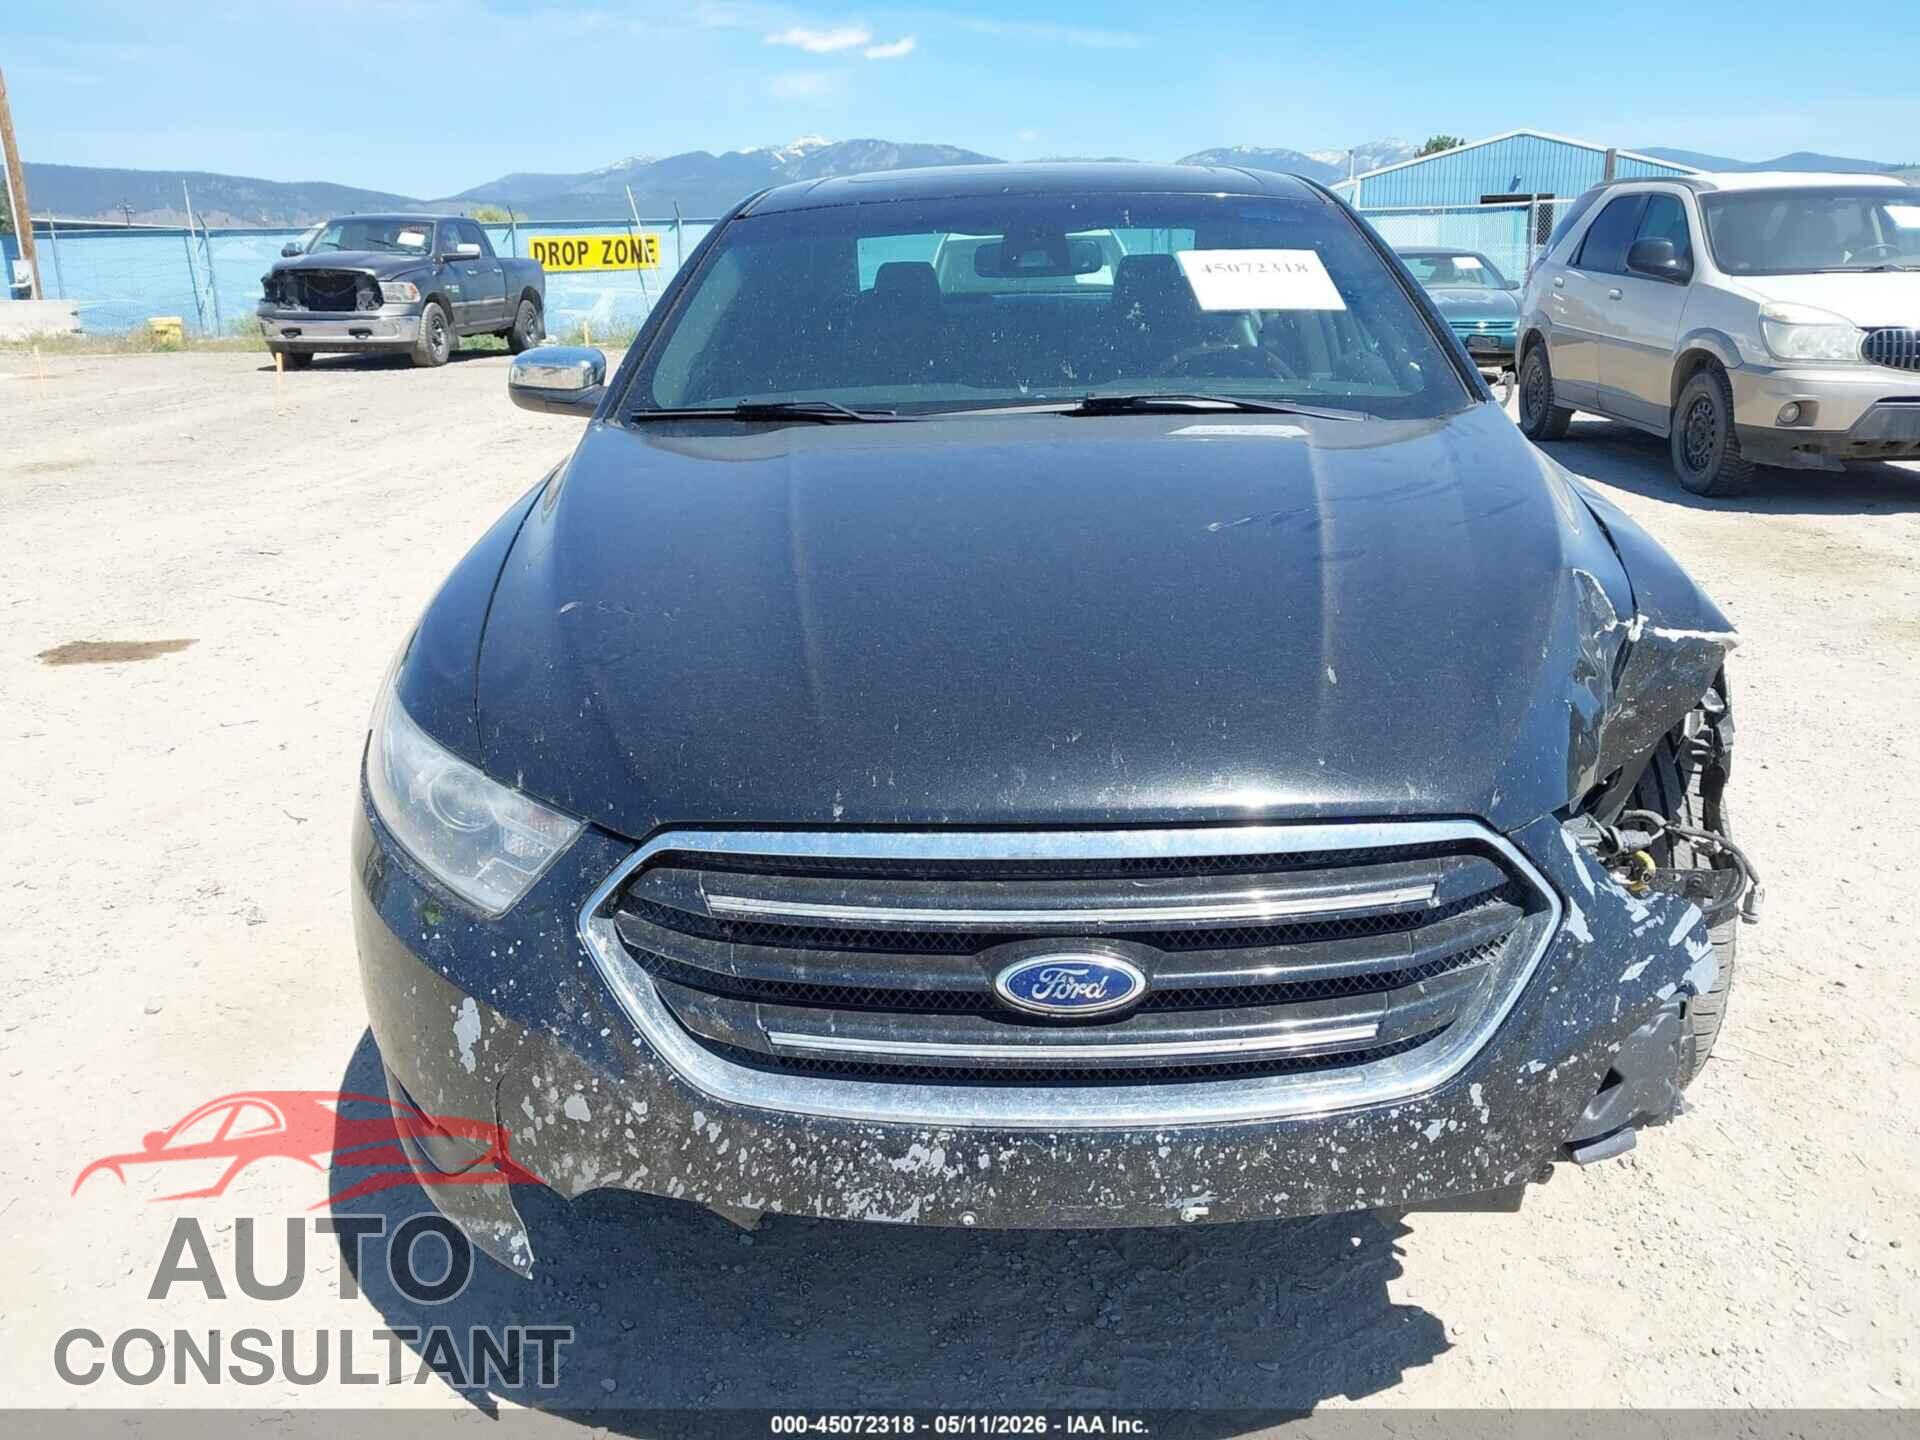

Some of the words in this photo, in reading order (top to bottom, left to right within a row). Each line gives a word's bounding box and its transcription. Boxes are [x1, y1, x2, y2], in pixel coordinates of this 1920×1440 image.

[534, 240, 589, 266] DROP
[602, 238, 656, 265] ZONE
[1201, 262, 1309, 274] 45072318
[1031, 966, 1108, 1000] Ford
